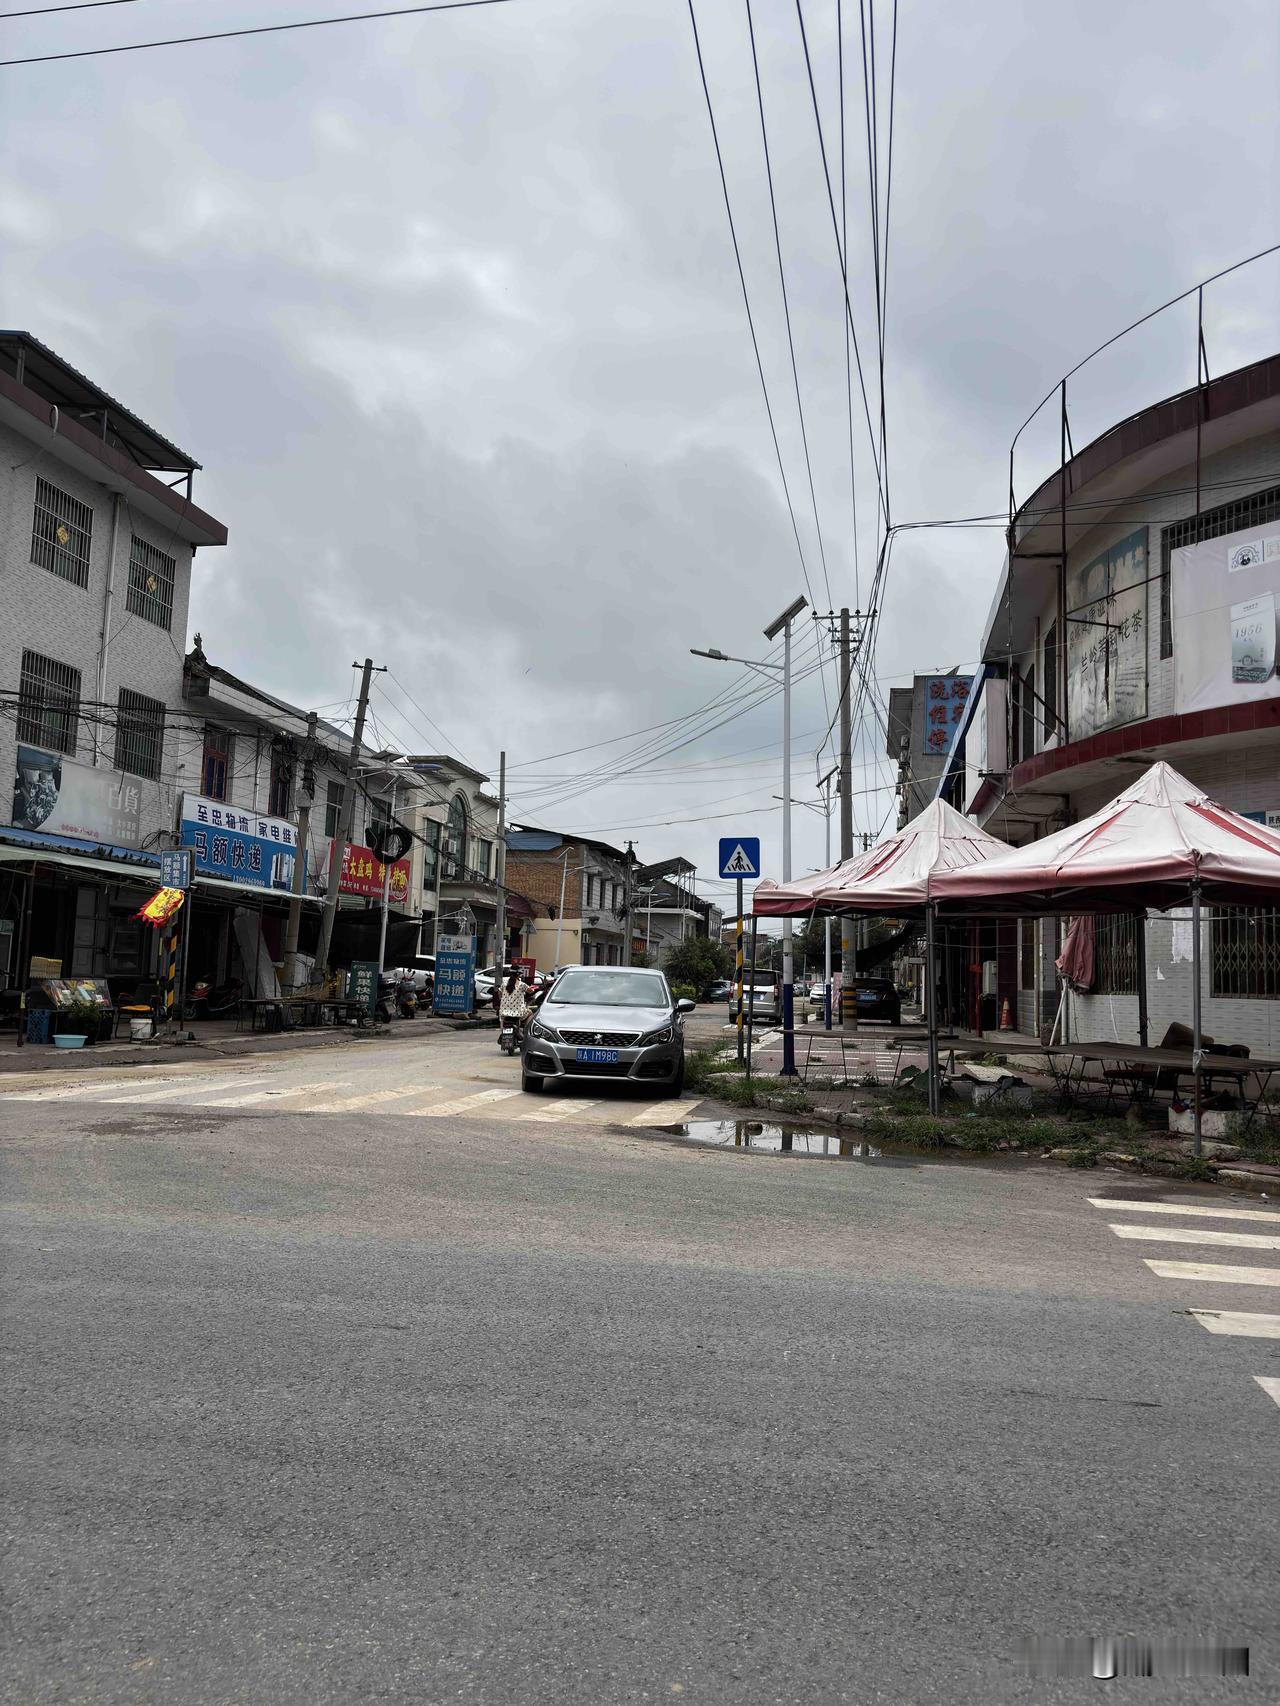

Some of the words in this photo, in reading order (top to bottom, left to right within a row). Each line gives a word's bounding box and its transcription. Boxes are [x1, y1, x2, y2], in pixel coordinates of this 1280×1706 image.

[197, 804, 249, 832] 至忠物流
[257, 822, 298, 845] 家电维
[195, 831, 261, 872] 马额快递
[349, 856, 372, 880] 大盘鸡
[438, 968, 466, 981] 马额
[437, 983, 465, 997] 快递
